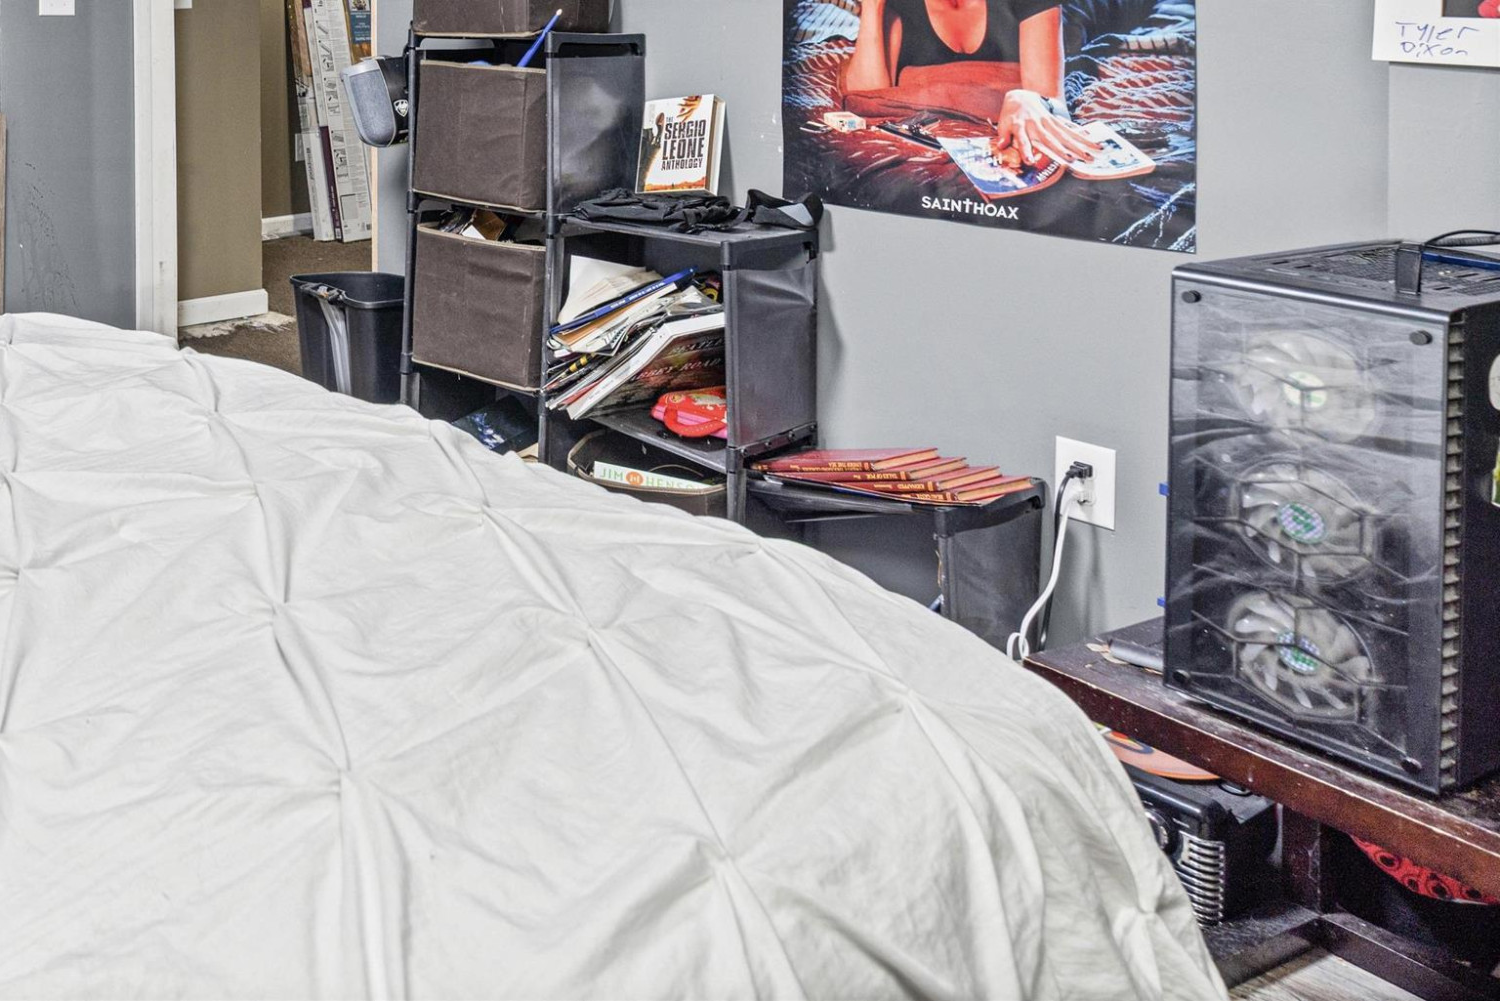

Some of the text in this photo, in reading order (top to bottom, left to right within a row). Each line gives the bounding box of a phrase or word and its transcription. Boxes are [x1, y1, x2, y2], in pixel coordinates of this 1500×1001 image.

[664, 119, 706, 140] SERGIO
[662, 138, 705, 160] LEONE
[661, 158, 703, 171] ANTHOLOGY
[600, 468, 701, 490] JIM HENSO
